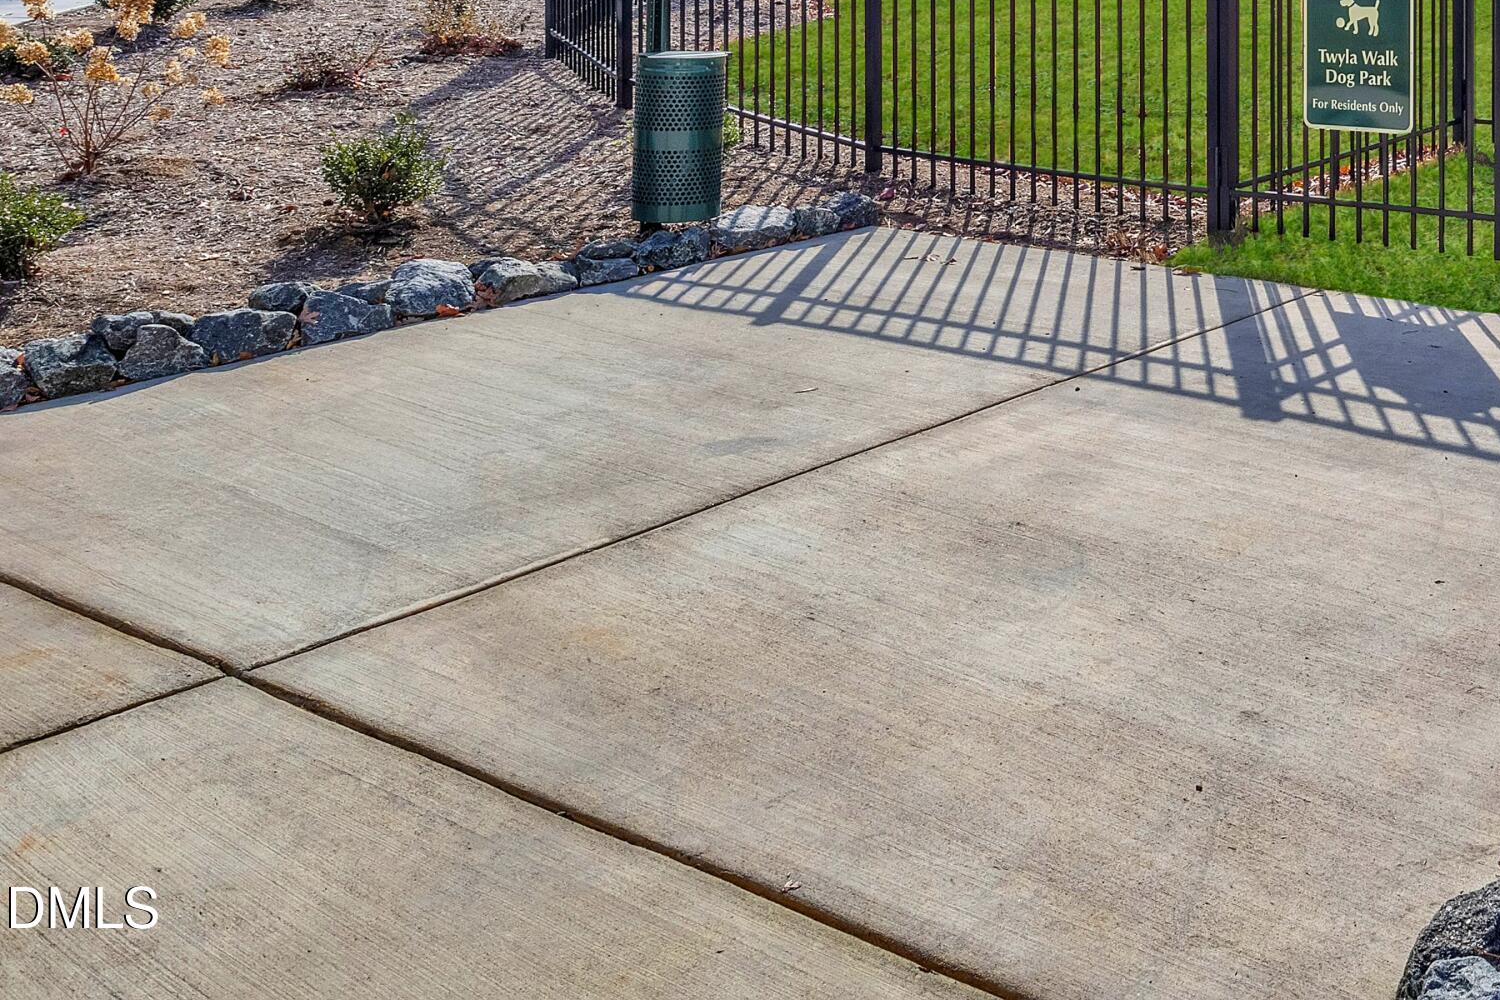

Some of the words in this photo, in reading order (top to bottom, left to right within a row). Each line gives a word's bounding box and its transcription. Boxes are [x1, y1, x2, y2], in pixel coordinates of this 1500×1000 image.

[1318, 49, 1358, 68] Twyla
[1362, 50, 1398, 66] Walk
[1326, 69, 1355, 88] Dog
[1360, 71, 1392, 86] Park
[1312, 98, 1328, 108] For
[1332, 100, 1376, 112] Residents
[1380, 102, 1404, 116] Only
